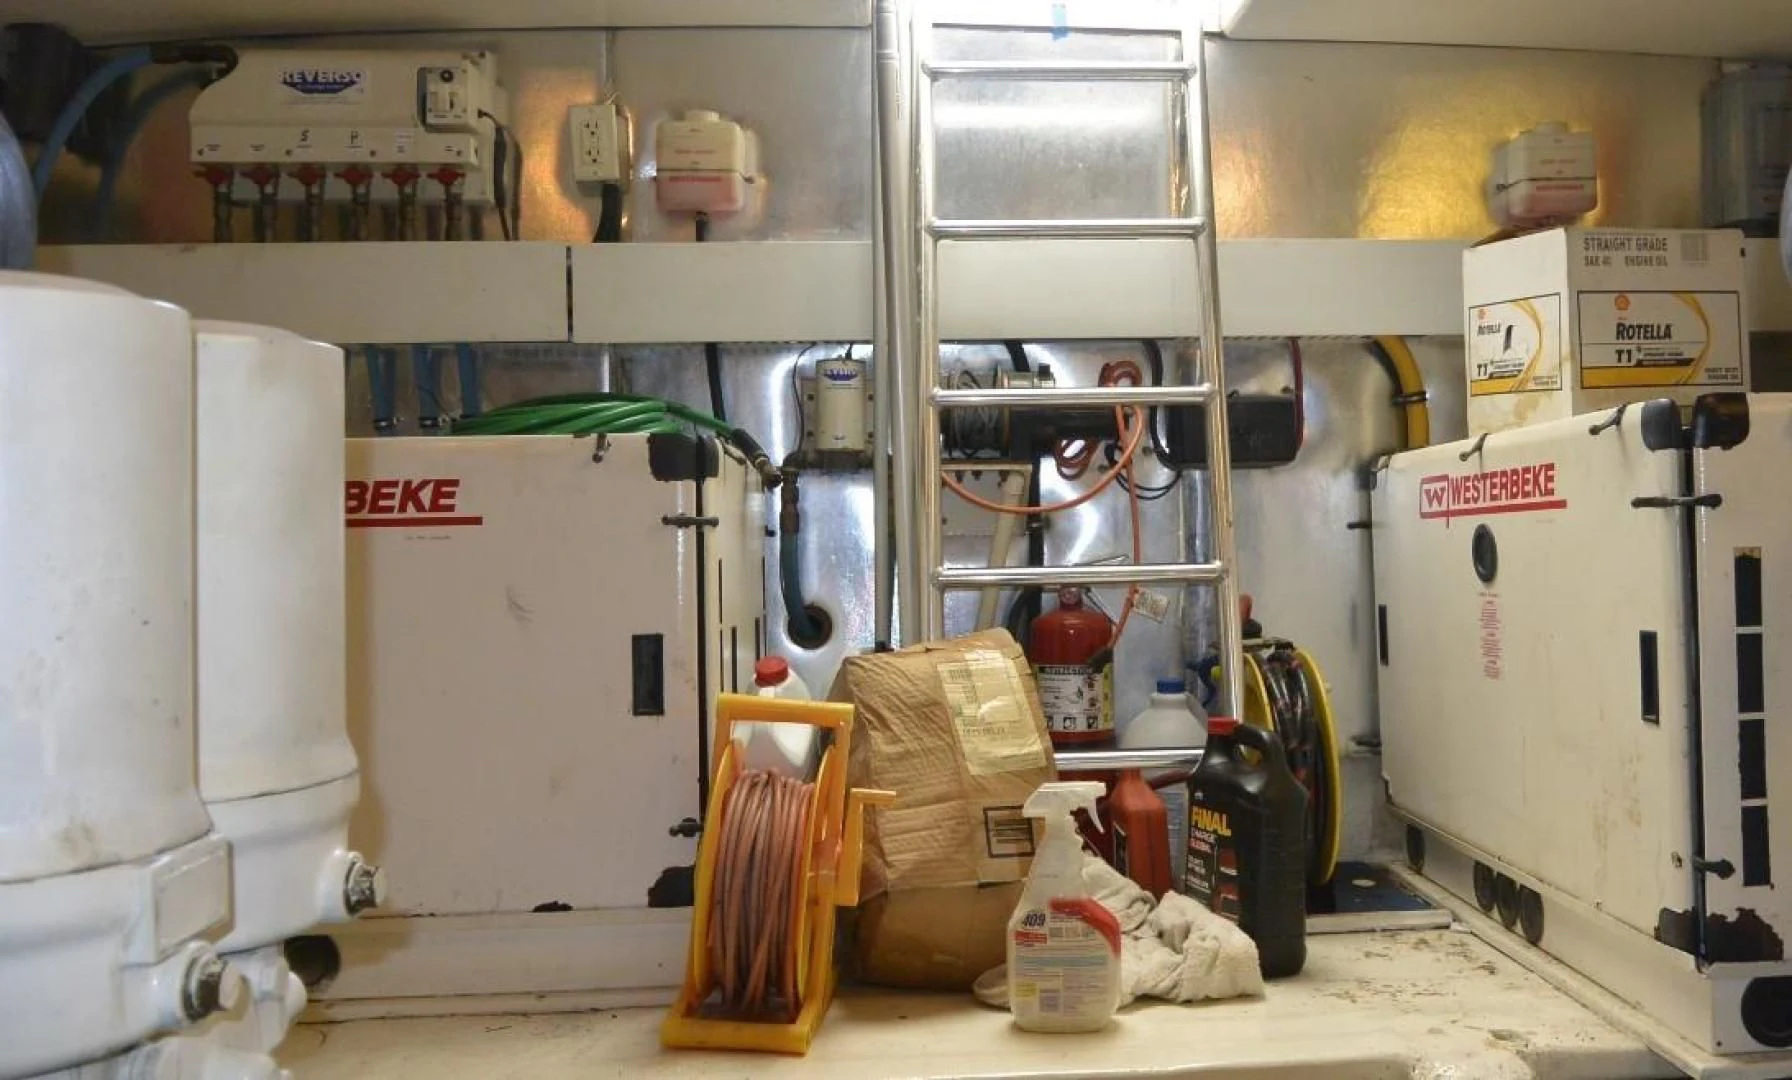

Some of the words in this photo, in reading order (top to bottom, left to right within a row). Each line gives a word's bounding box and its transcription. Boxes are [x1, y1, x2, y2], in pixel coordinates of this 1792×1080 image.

[1584, 237, 1632, 252] STRAIGHT
[1635, 237, 1668, 252] GRADE
[1615, 349, 1632, 364] T1
[1477, 362, 1488, 377] T1
[1424, 485, 1446, 509] W
[1451, 463, 1556, 506] WESTERBEKE
[1191, 805, 1232, 837] FINAL
[1022, 912, 1046, 927] 409
